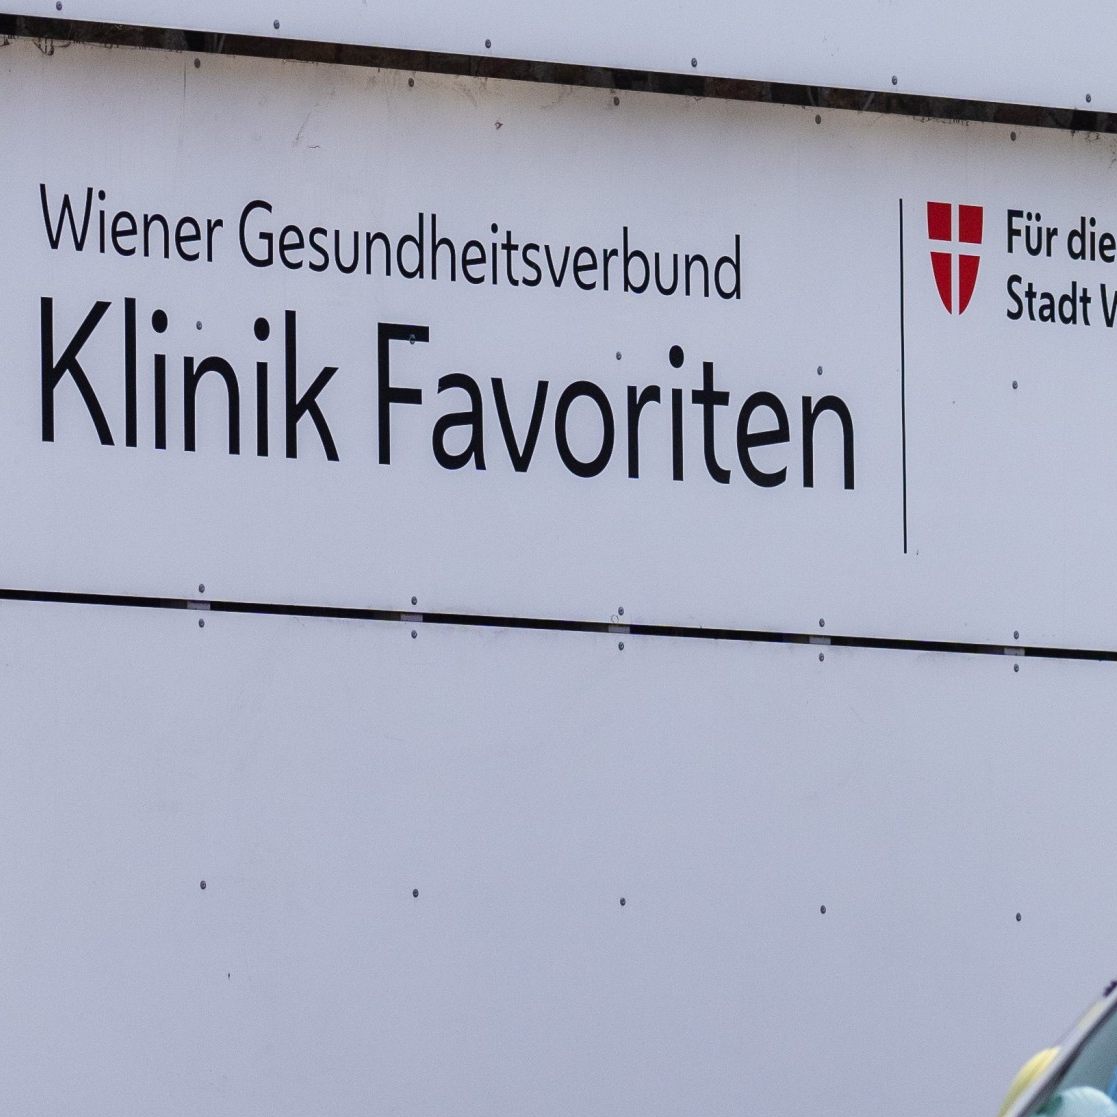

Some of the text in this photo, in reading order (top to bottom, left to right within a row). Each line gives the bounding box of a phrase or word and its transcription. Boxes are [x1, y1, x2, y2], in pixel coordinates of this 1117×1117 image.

[40, 184, 741, 299] Wiener Gesundheitsverbund
[1007, 209, 1117, 264] Für die
[1006, 274, 1092, 326] Stadt
[41, 296, 855, 489] Klinik Favoriten
